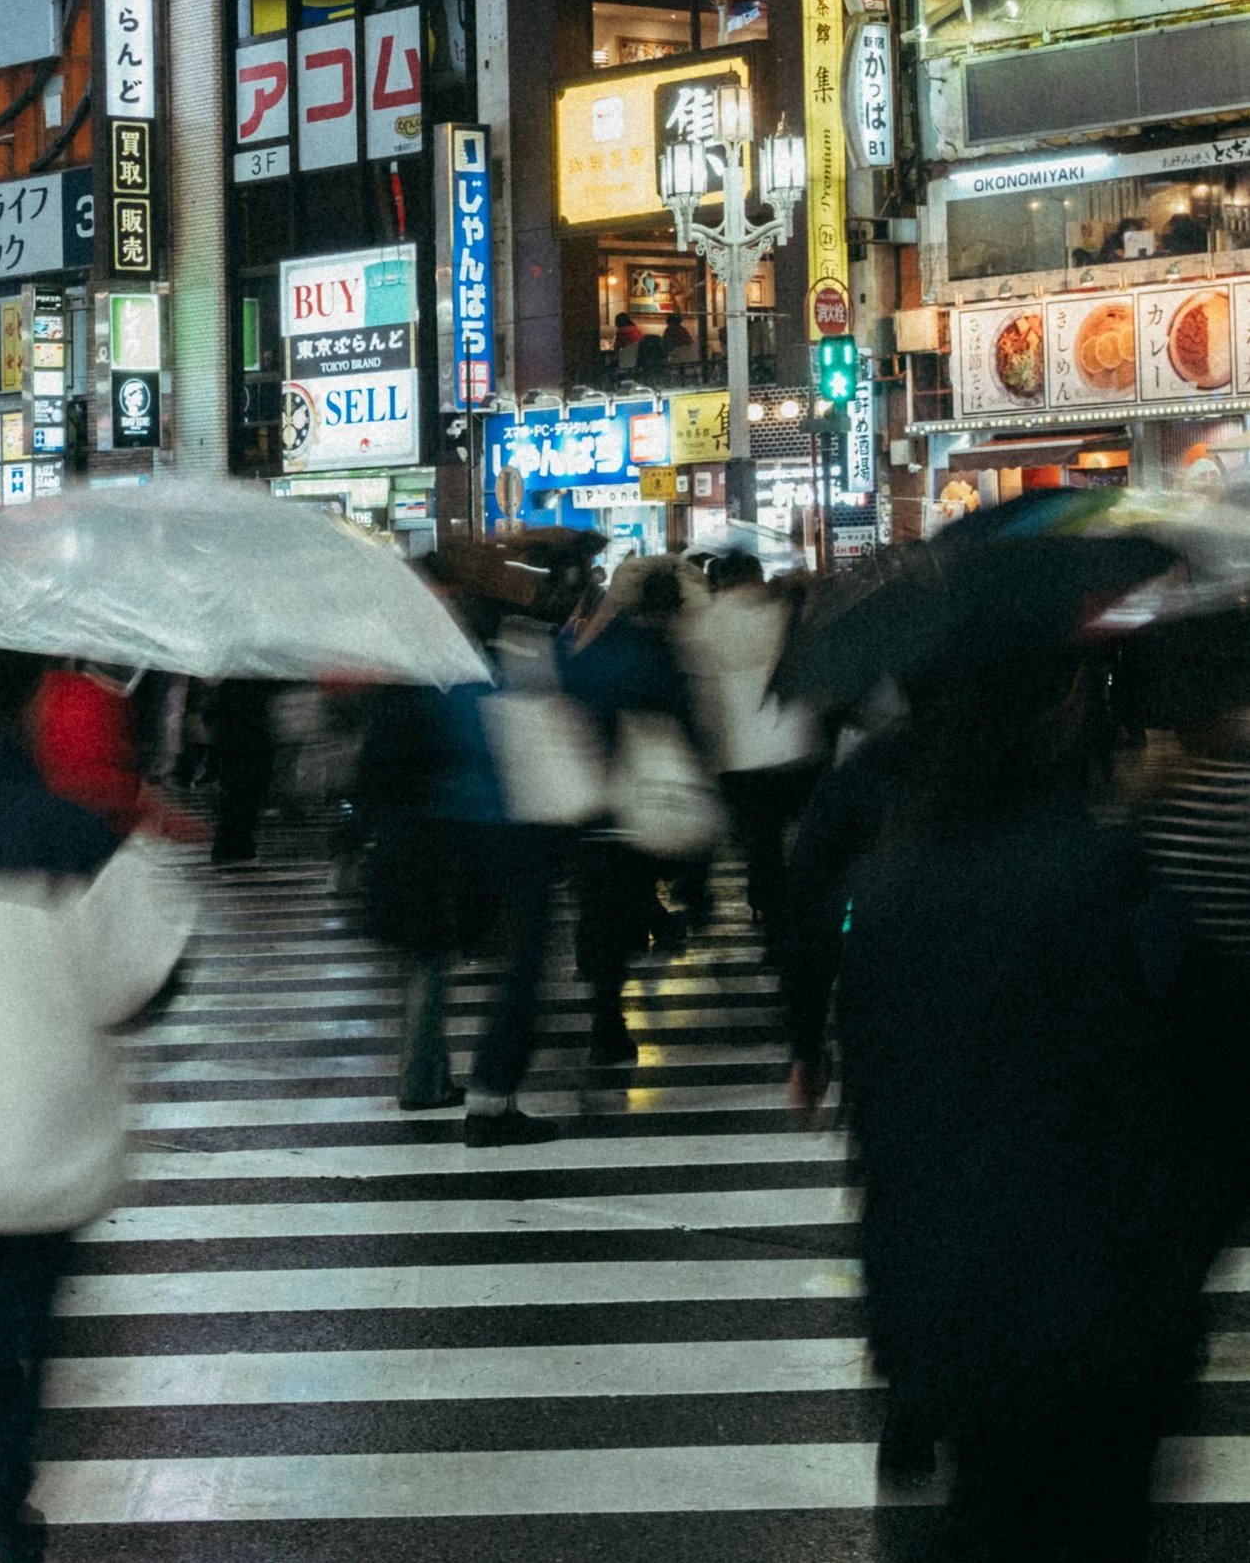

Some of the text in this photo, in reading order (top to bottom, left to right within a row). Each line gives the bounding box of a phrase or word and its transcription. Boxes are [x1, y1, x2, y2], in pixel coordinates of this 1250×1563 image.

[239, 35, 422, 139] アコム
[813, 65, 835, 104] 集
[864, 51, 887, 131] かっぱ
[119, 131, 143, 186] 買取
[251, 150, 278, 175] 3F
[869, 140, 886, 157] B1
[974, 164, 1085, 193] OKONOMIYAKI
[75, 194, 94, 238] 3
[120, 208, 145, 263] 販売
[293, 278, 360, 320] BUY
[816, 303, 846, 325] 消火栓
[319, 357, 382, 373] TOKYO BRAND
[1054, 308, 1071, 403] きしめん
[1146, 302, 1169, 389] カレー
[324, 385, 408, 426] SELL
